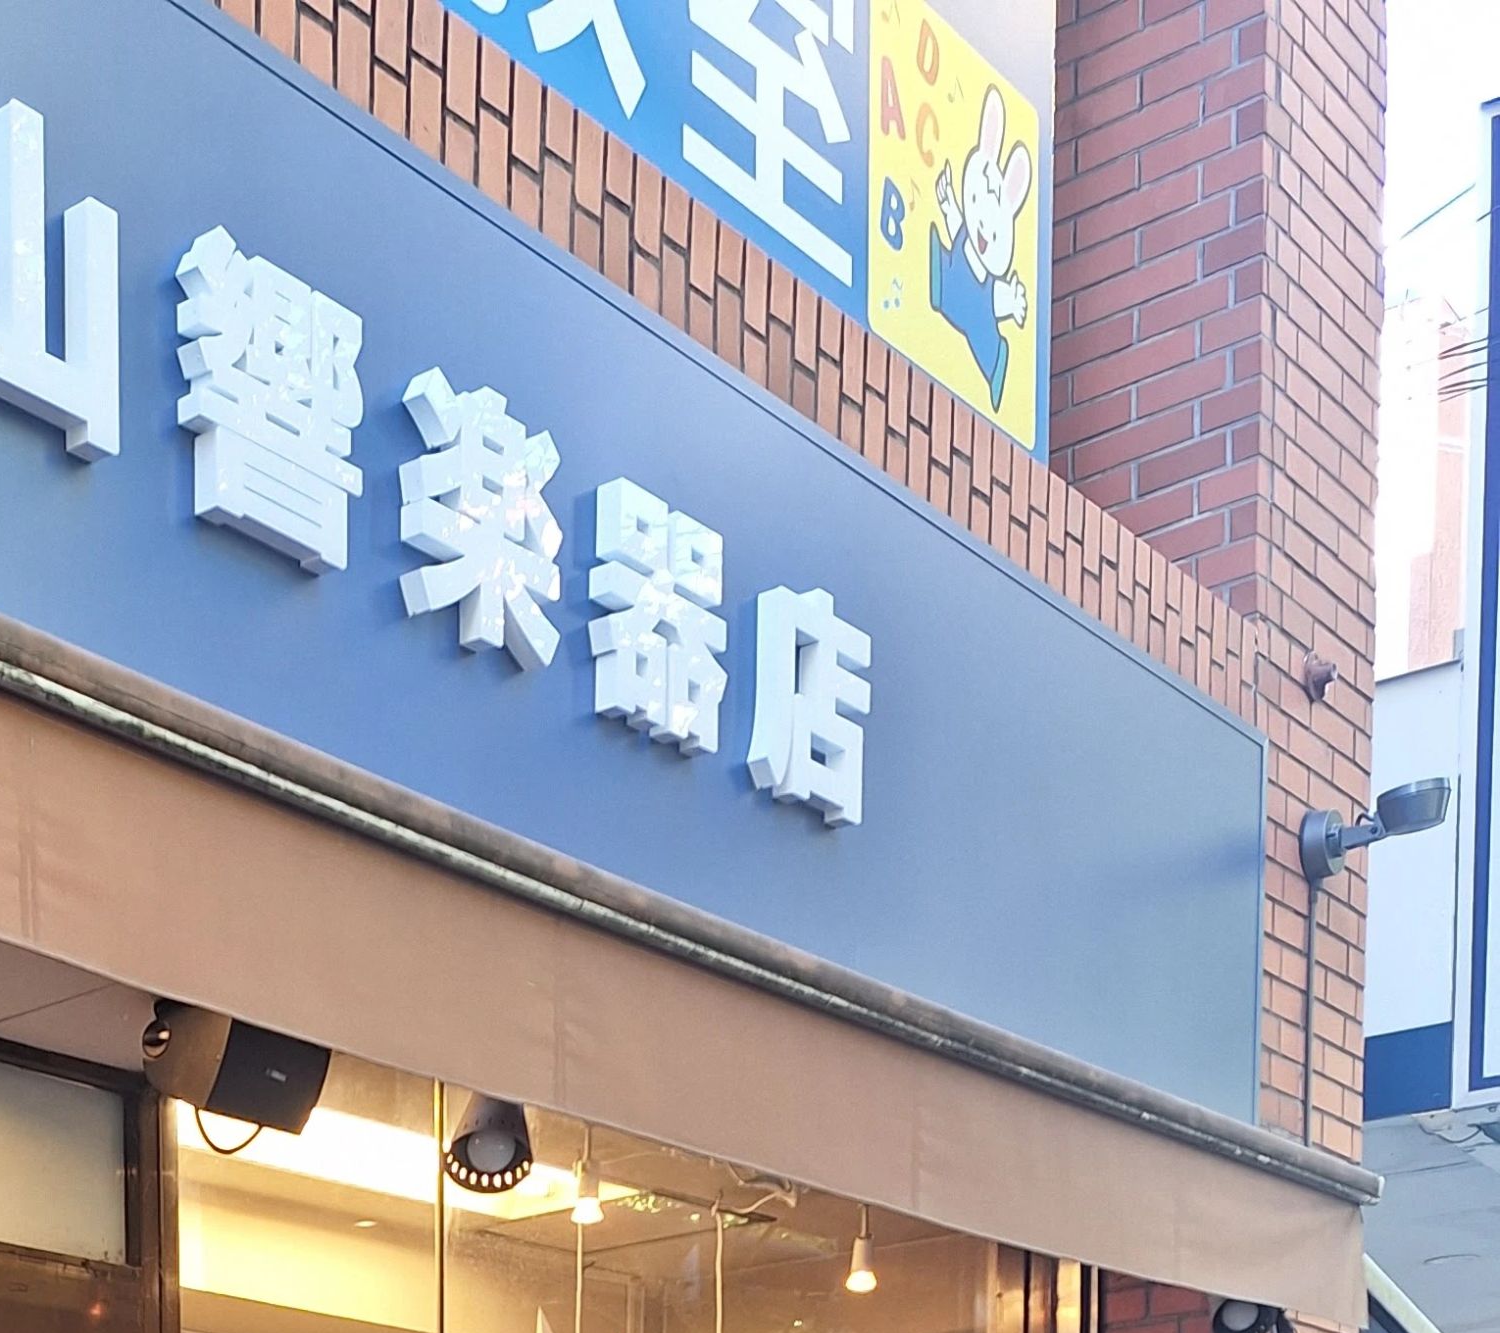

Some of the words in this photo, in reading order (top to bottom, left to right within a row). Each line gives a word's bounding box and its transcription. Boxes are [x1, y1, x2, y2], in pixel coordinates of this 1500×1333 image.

[917, 19, 940, 86] D
[881, 56, 906, 141] A
[916, 102, 940, 168] C
[880, 176, 905, 251] B
